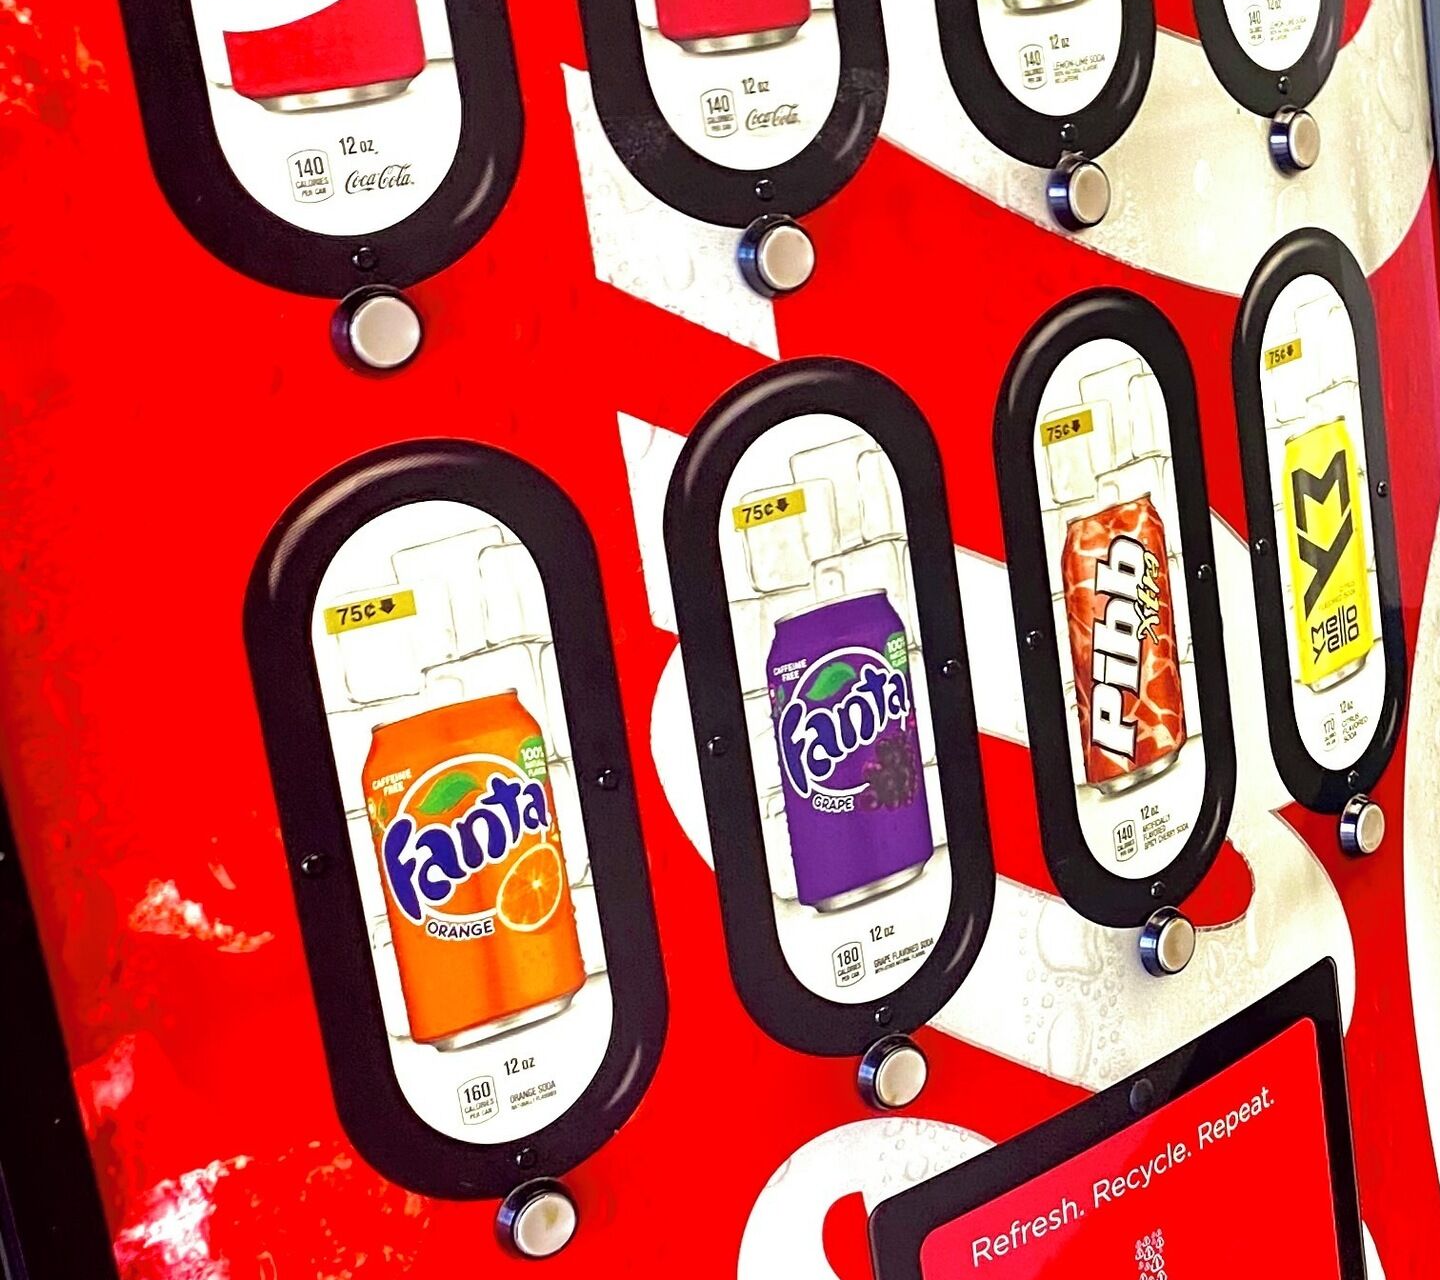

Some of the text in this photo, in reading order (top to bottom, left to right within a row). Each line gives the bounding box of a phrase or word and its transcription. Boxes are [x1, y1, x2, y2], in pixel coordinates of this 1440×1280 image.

[741, 77, 757, 95] 12
[706, 94, 730, 115] 140
[338, 135, 358, 156] 12
[294, 156, 325, 178] 140
[345, 163, 415, 195] Coca-Cola
[742, 503, 774, 524] 75¢
[336, 601, 377, 626] 75¢
[812, 792, 855, 813] GRAPE
[1140, 805, 1150, 821] 12
[1116, 824, 1134, 844] 140
[426, 918, 495, 940] ORANGE
[869, 925, 883, 943] 12
[836, 946, 860, 968] 180
[503, 1056, 536, 1076] 12 oz
[463, 1080, 492, 1104] 160
[971, 1086, 1276, 1268] Refresh. Recycle. Repeat.
